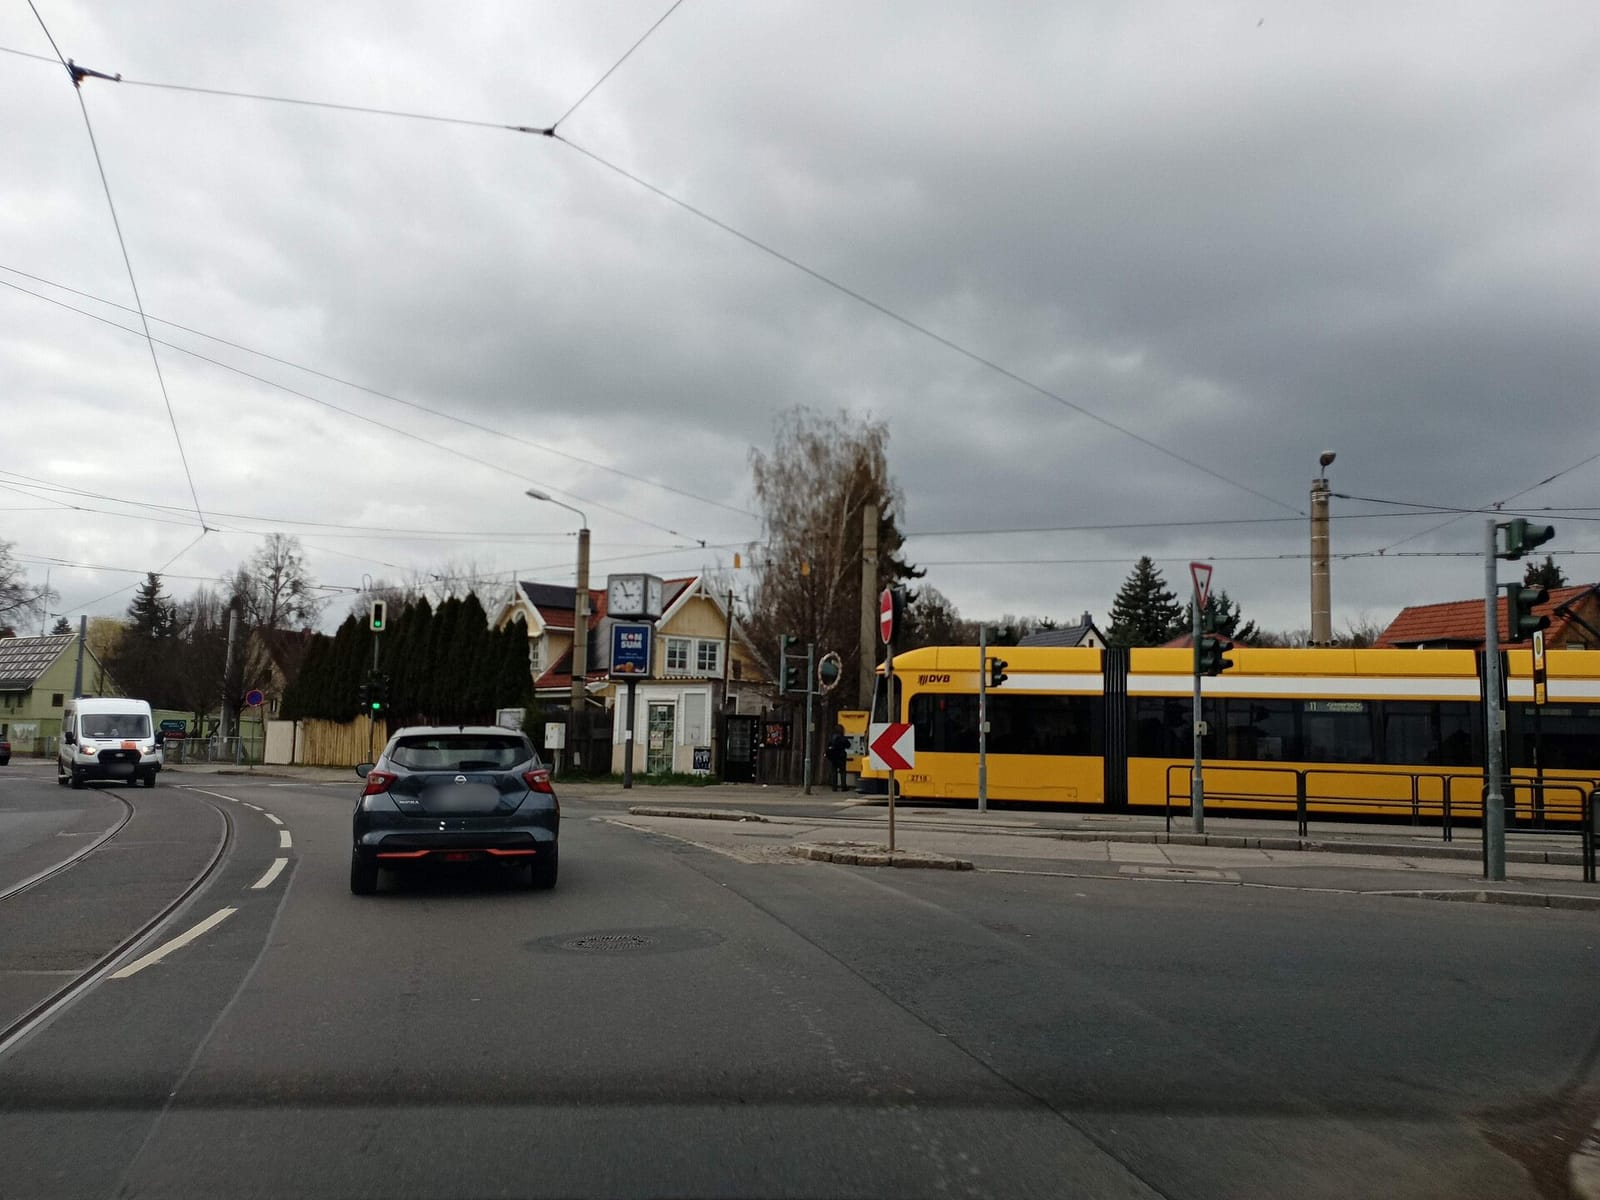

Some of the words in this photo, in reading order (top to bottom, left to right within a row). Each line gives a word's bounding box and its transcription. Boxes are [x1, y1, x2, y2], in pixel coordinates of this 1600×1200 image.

[621, 632, 643, 641] KON
[621, 641, 643, 649] SUM
[929, 674, 951, 683] DVB
